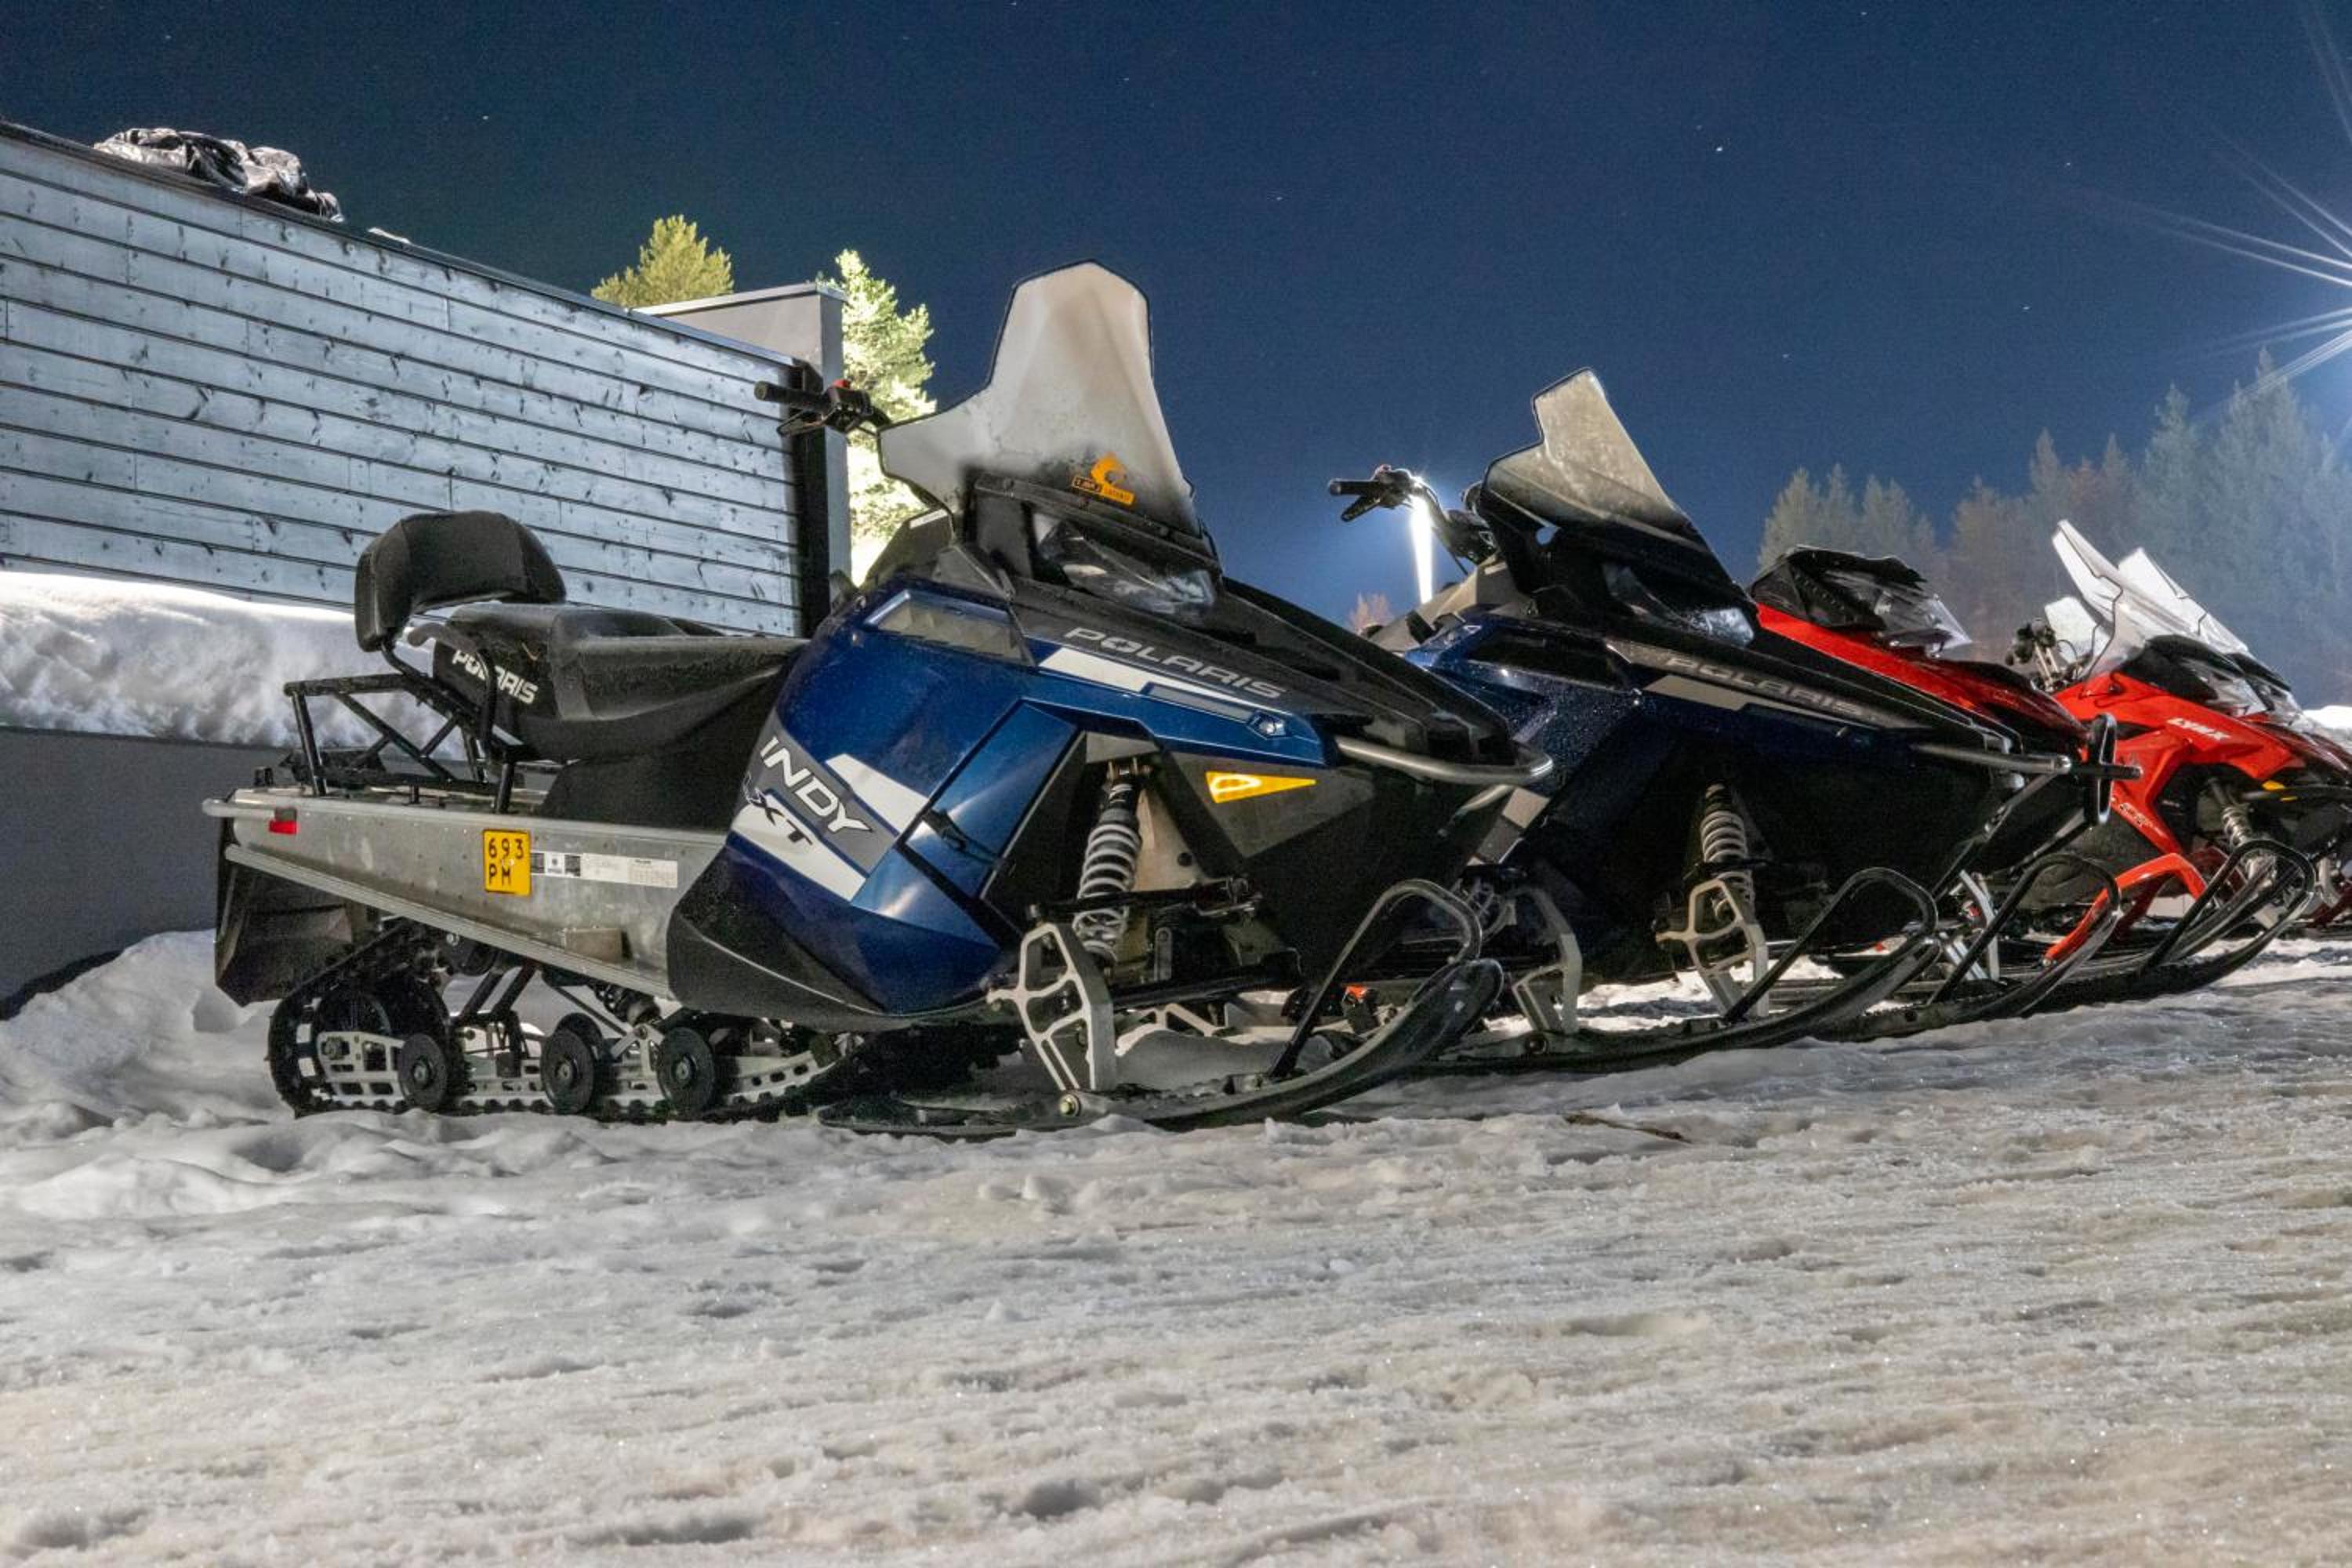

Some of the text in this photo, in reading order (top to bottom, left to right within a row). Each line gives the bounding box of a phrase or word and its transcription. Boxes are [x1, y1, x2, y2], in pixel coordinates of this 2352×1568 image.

[1064, 626, 1287, 699] POLARIS
[1665, 655, 1863, 715] POLARIS
[760, 736, 873, 833] INDY
[488, 837, 524, 860] 693
[488, 863, 511, 887] PM
